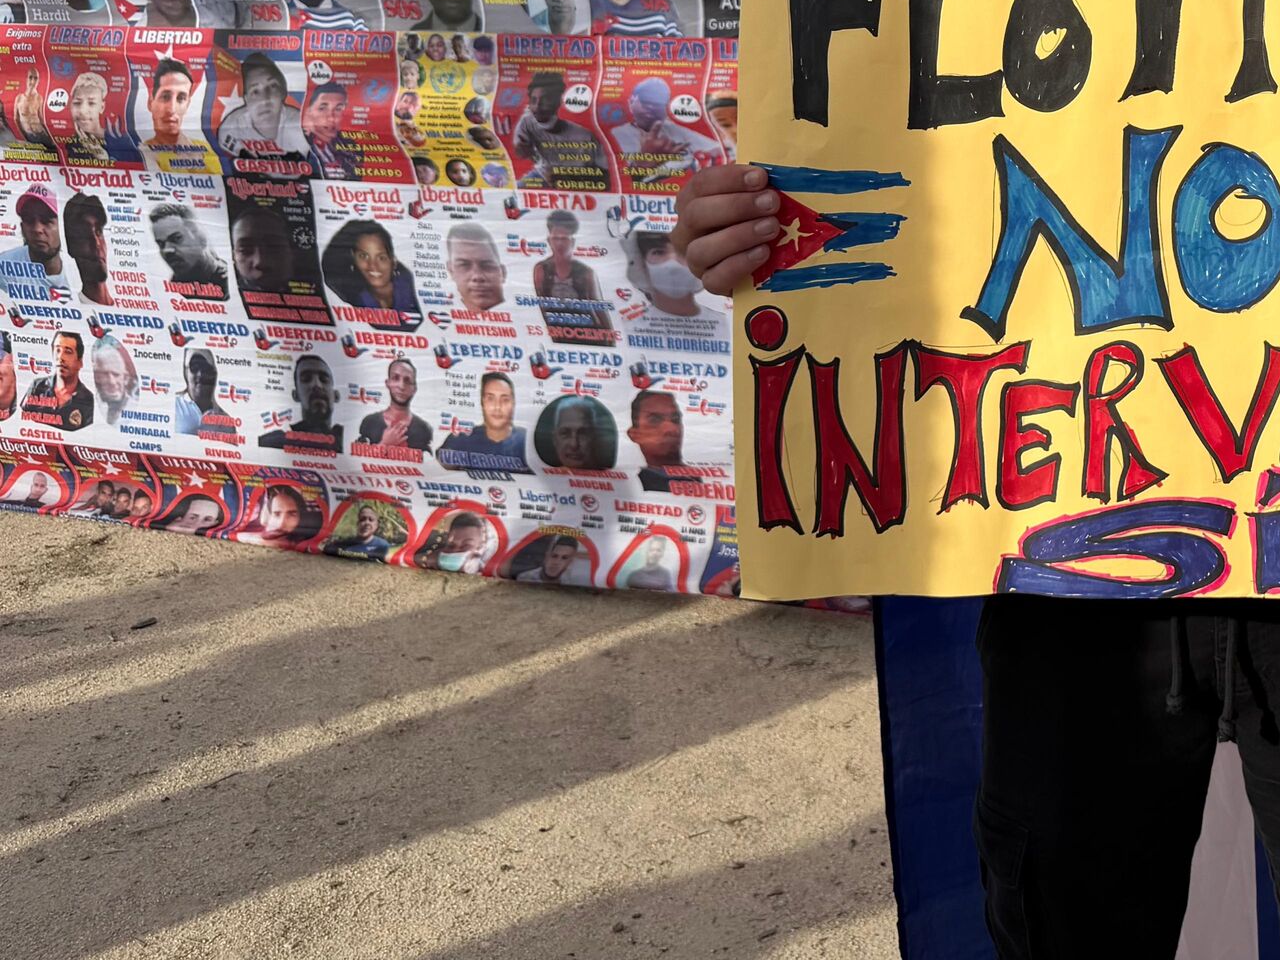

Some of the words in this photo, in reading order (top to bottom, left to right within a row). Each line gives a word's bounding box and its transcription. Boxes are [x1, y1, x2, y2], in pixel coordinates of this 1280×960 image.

[383, 0, 423, 20] SOS
[6, 28, 42, 38] Exigimos
[50, 27, 123, 47] LIBERTAD
[134, 30, 203, 45] LIBERTAD
[12, 43, 32, 51] extra
[310, 33, 393, 52] LIBERTAD
[503, 37, 596, 59] LIBERTAD
[609, 39, 706, 61] LIBERTAD
[14, 55, 36, 64] penal
[234, 159, 312, 177] CASTILLO
[354, 169, 402, 177] RICARDO
[553, 167, 603, 176] BECERRA
[60, 166, 133, 192] Libertad
[156, 173, 215, 190] Libertad
[556, 181, 606, 190] CURBELO
[633, 182, 680, 191] FRANCO
[326, 186, 402, 205] Libertad
[113, 248, 132, 257] fiscal
[0, 261, 45, 279] YADIER
[119, 260, 137, 268] años
[109, 270, 147, 283] YORDIS
[8, 284, 50, 301] AYALA
[114, 298, 158, 310] FORNIER
[170, 299, 227, 315] Sánchez
[332, 307, 401, 325] YUNAIKI
[456, 324, 517, 338] MONTESINO
[13, 334, 49, 345] Inocente
[628, 334, 665, 349] RENIEL
[133, 349, 171, 360] Inocente
[216, 356, 252, 367] Inocente
[121, 410, 170, 423] HUMBERTO
[20, 428, 64, 441] CASTELL
[120, 425, 171, 438] MONRABAL
[129, 441, 162, 452] CAMPS
[204, 448, 242, 459] RIVERO
[72, 445, 130, 464] Libertad
[362, 463, 424, 477] AGUILERA
[417, 480, 483, 495] LIBERTAD
[518, 487, 577, 507] Libertad
[614, 500, 683, 518] LIBERTAD
